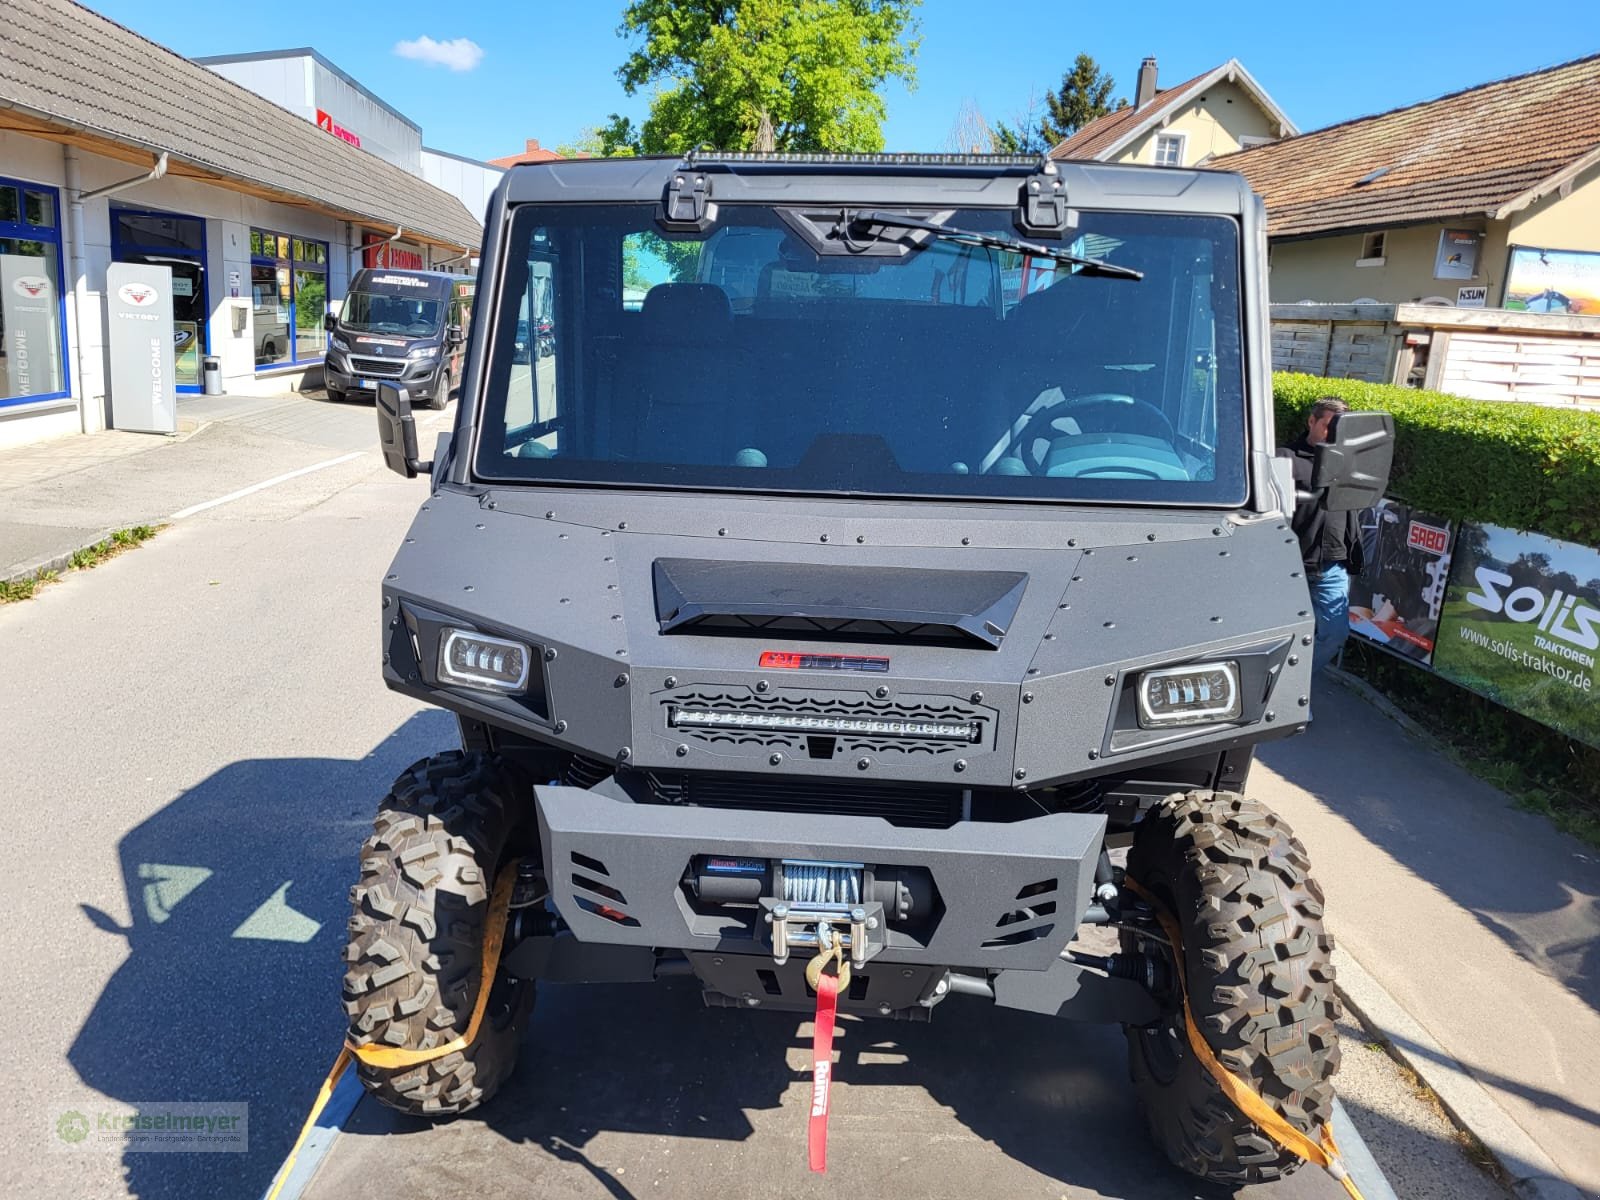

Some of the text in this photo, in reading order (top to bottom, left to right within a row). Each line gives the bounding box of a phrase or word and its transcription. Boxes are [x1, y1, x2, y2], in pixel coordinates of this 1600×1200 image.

[118, 312, 160, 321] VICTORY
[151, 337, 162, 405] WELCOME
[1410, 524, 1447, 552] SABO
[1460, 625, 1592, 692] www.solis-traktor.de
[1533, 634, 1595, 669] TRAKTOREN
